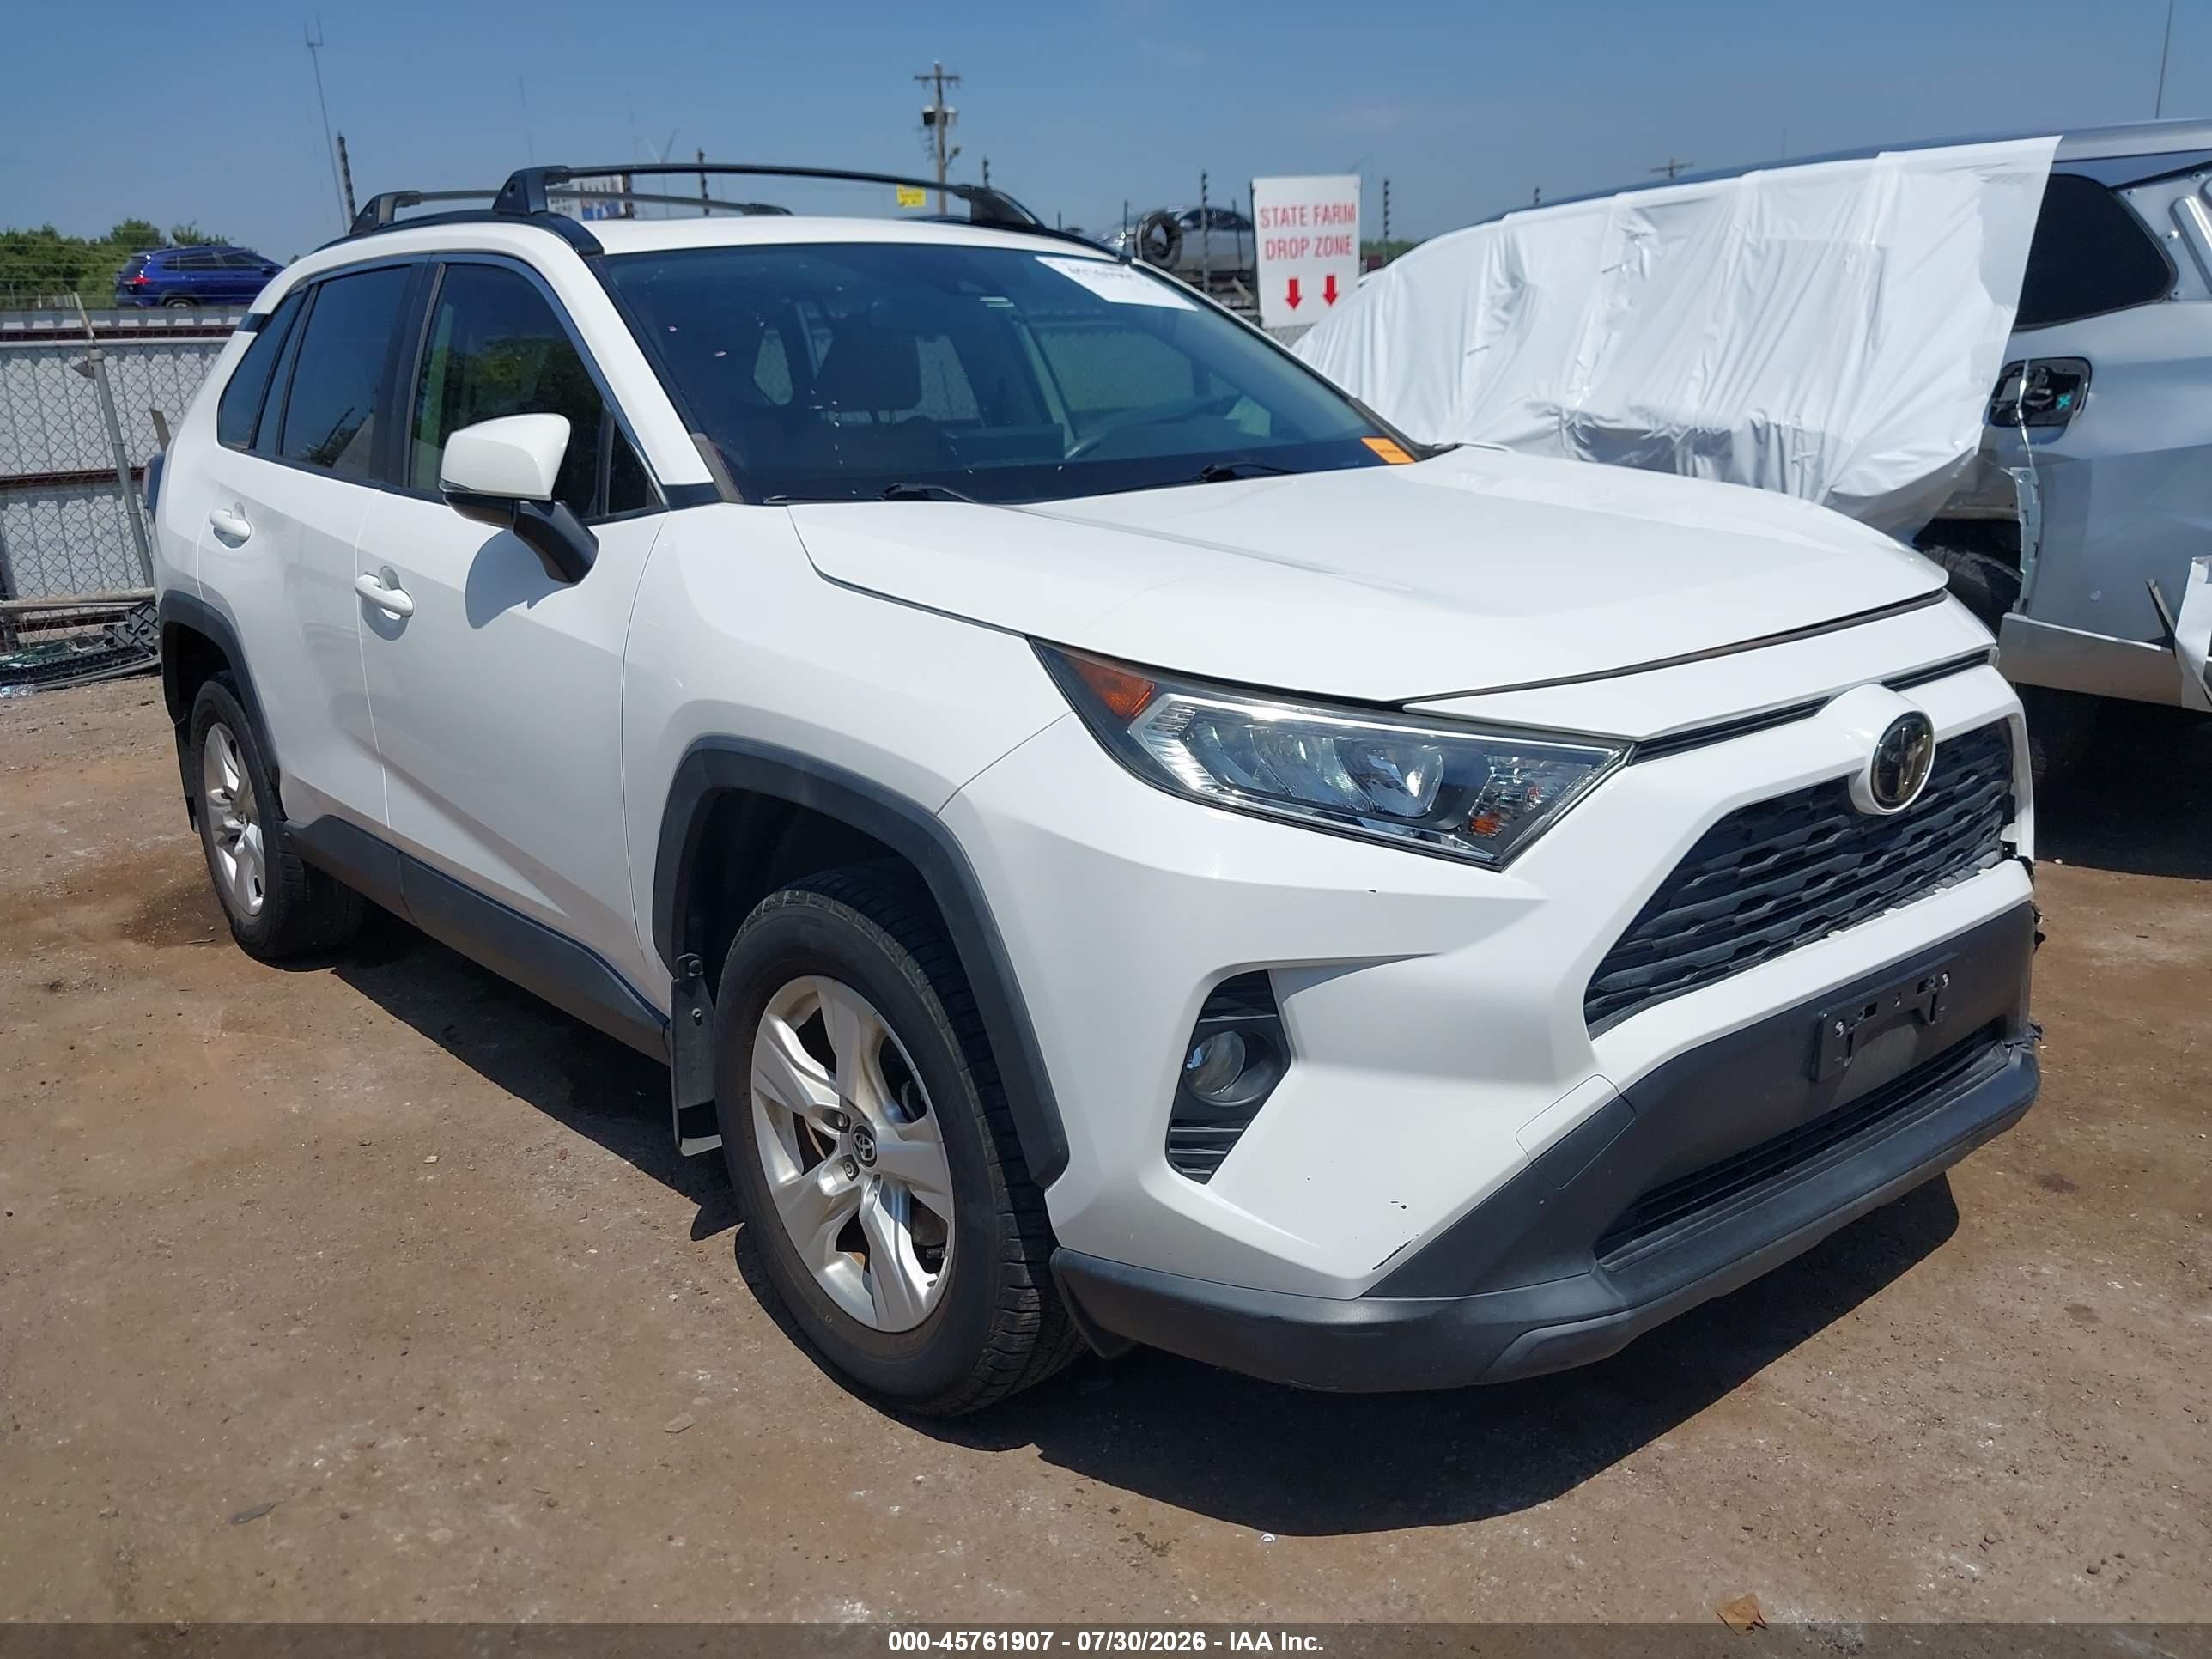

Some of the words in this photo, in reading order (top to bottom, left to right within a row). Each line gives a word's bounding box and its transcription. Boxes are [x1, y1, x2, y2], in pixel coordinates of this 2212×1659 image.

[1259, 204, 1308, 228] STATE
[1313, 202, 1356, 226] FARM
[1265, 238, 1310, 261] DROP
[1315, 234, 1353, 258] ZONE
